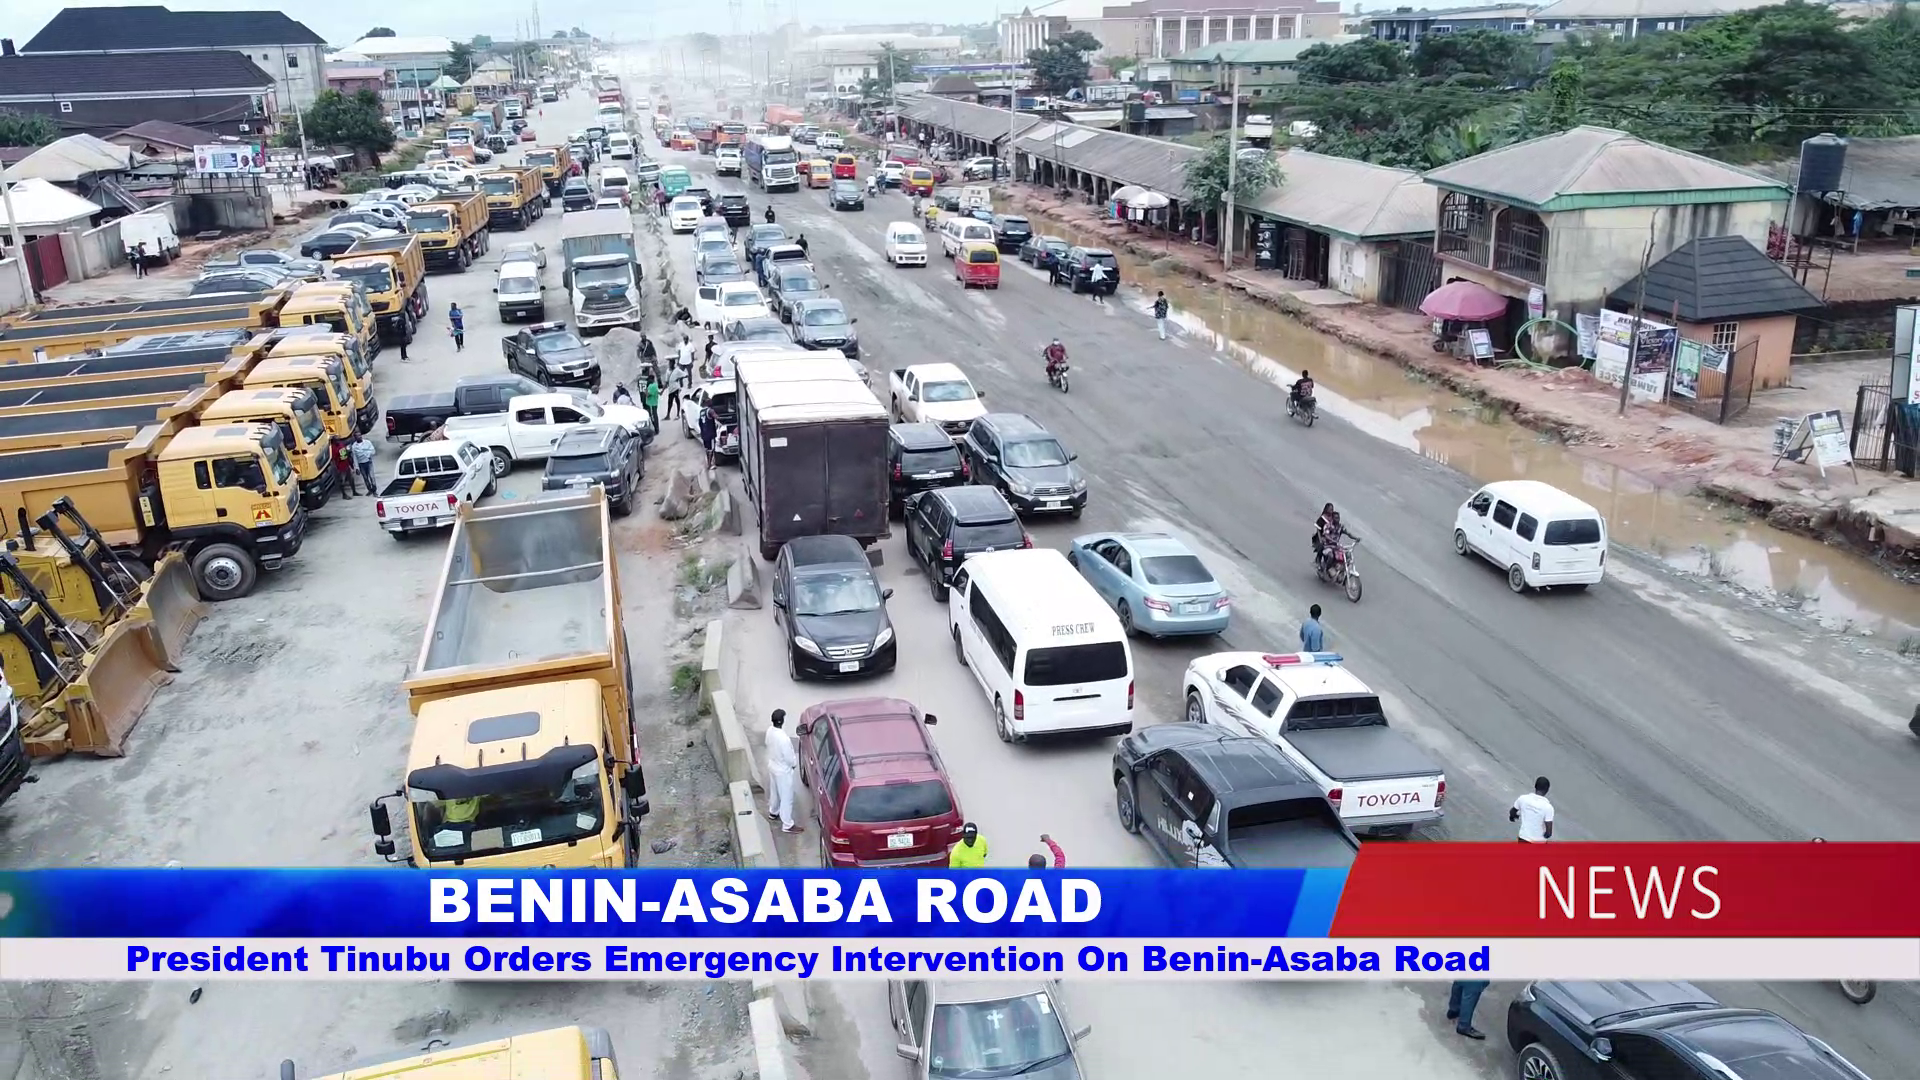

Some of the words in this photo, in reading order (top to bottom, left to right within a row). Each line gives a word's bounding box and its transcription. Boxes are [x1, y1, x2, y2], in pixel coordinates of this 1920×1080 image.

[394, 502, 439, 514] TOYOTA
[1052, 624, 1074, 636] PRESS
[1075, 622, 1095, 634] CREW
[1357, 792, 1421, 808] TOYOTA
